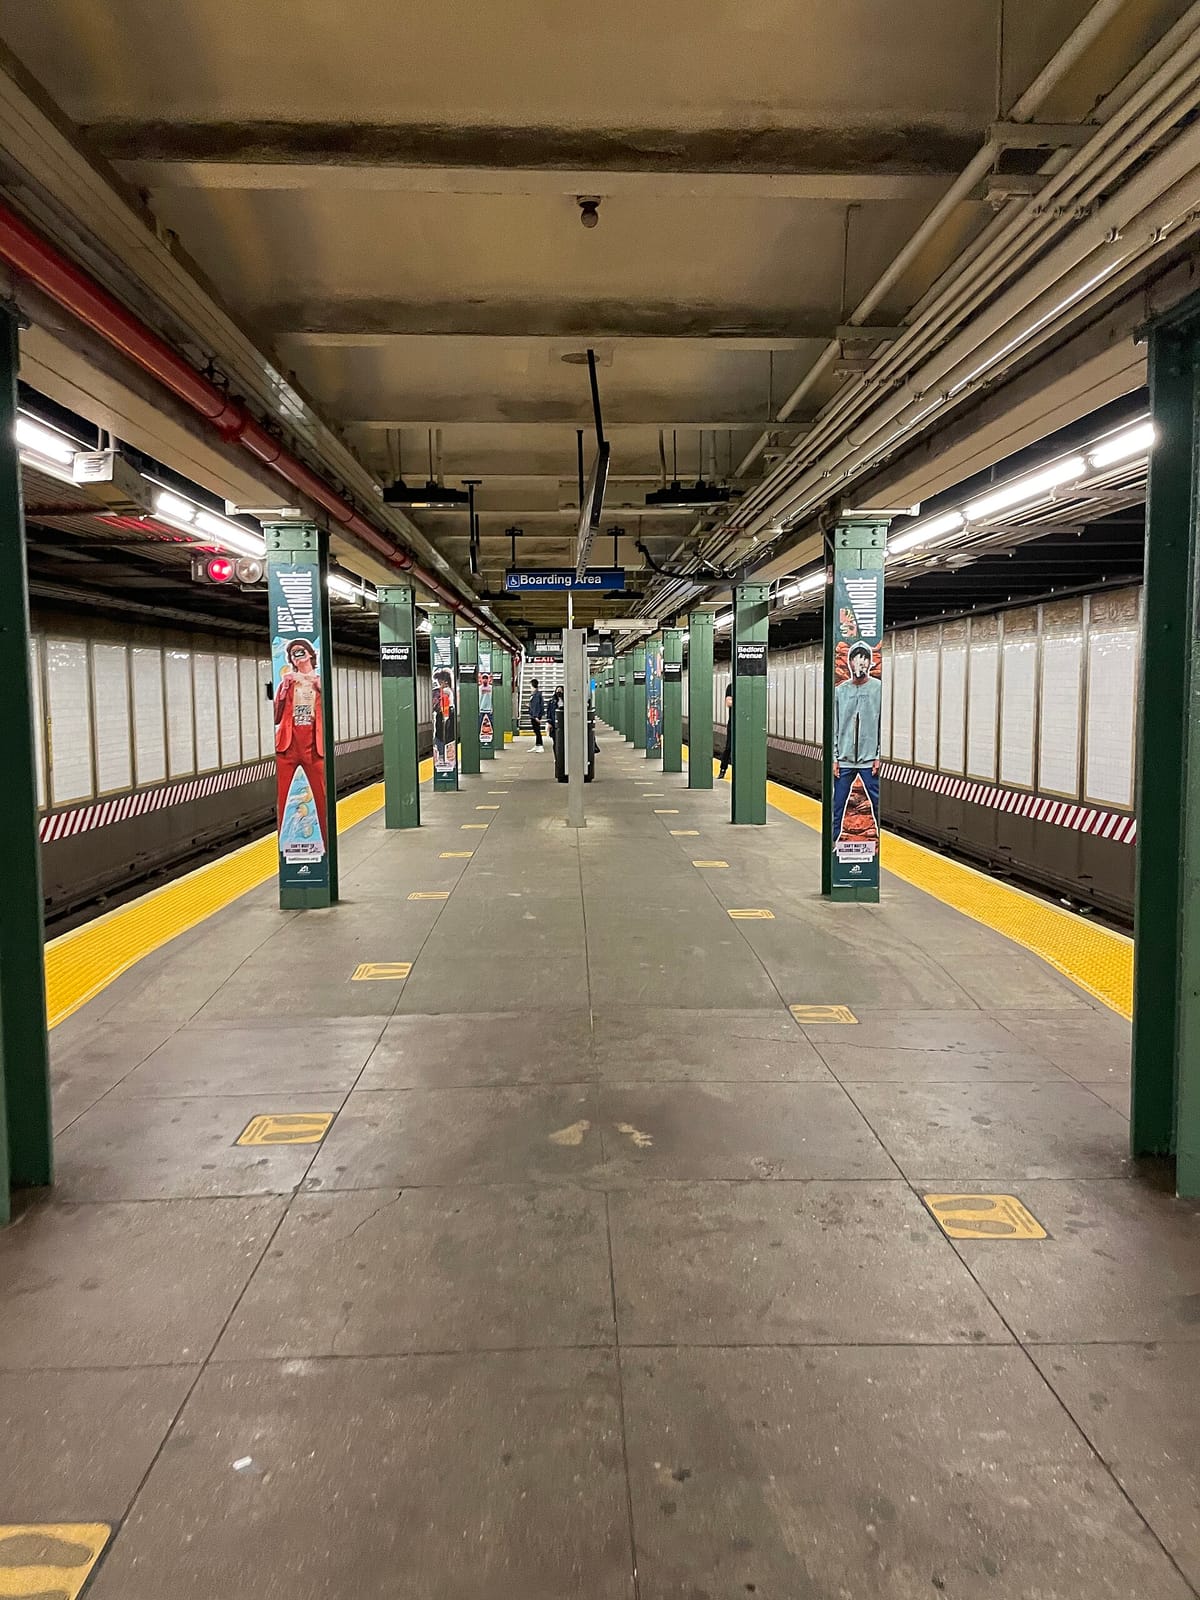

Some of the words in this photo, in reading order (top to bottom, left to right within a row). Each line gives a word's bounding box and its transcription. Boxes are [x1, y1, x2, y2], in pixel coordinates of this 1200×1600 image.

[276, 571, 314, 633] BALTIMORE
[520, 575, 572, 586] Boarding
[575, 575, 602, 584] Area
[277, 606, 297, 633] VISIT
[843, 576, 877, 637] BALTIMORE
